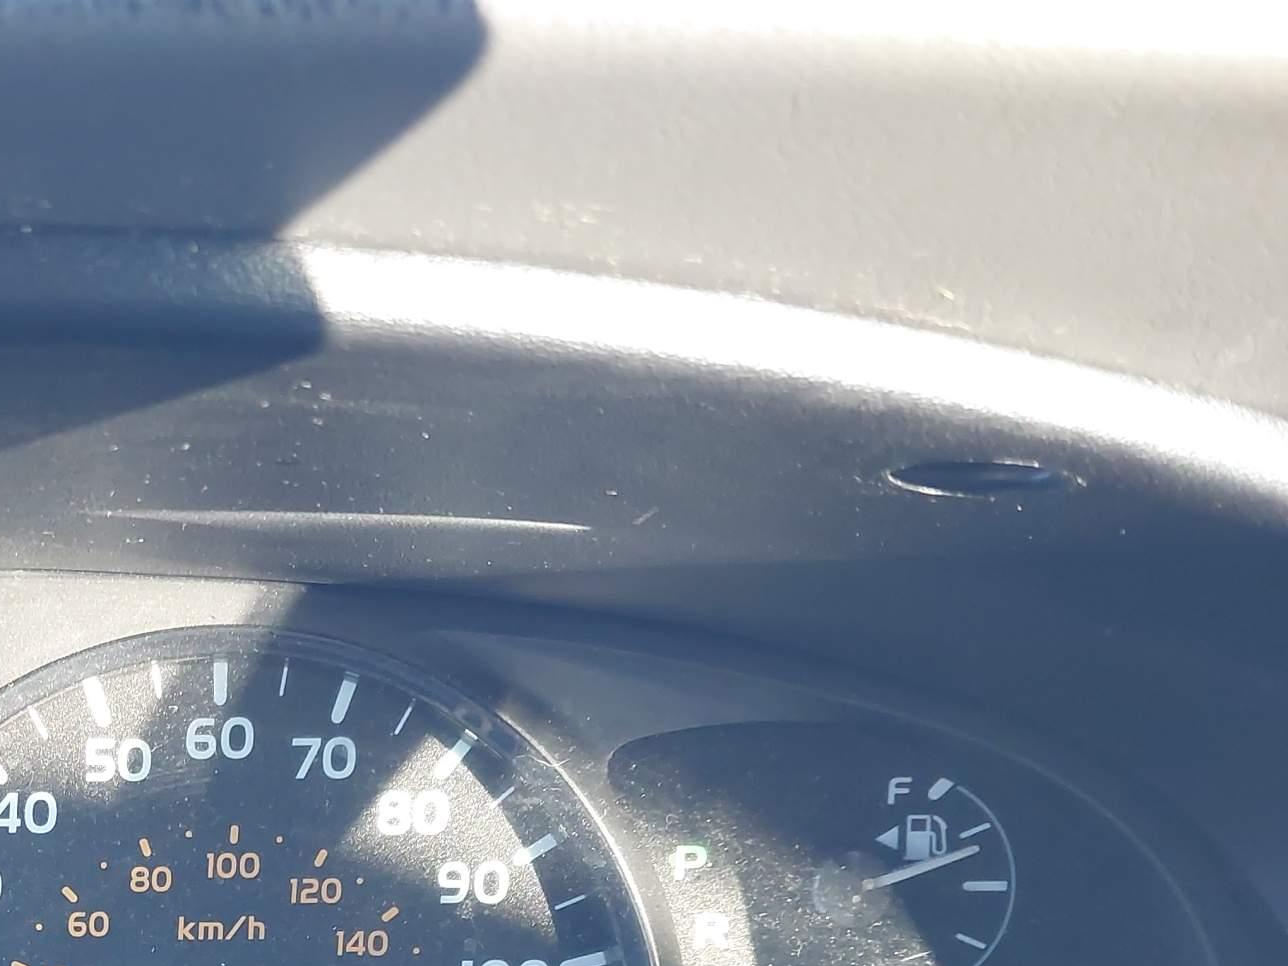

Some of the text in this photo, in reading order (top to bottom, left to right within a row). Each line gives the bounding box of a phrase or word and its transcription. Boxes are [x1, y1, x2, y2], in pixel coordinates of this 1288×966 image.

[185, 717, 254, 760] 60
[85, 740, 152, 783] 50
[291, 738, 357, 779] 70
[887, 777, 913, 805] F
[376, 792, 449, 834] 80
[205, 852, 261, 879] 100
[672, 845, 708, 880] P
[129, 866, 174, 893] 80
[289, 878, 343, 905] 120
[438, 862, 509, 905] 90
[67, 911, 110, 938] 60
[176, 915, 267, 942] km/h
[335, 930, 390, 957] 140
